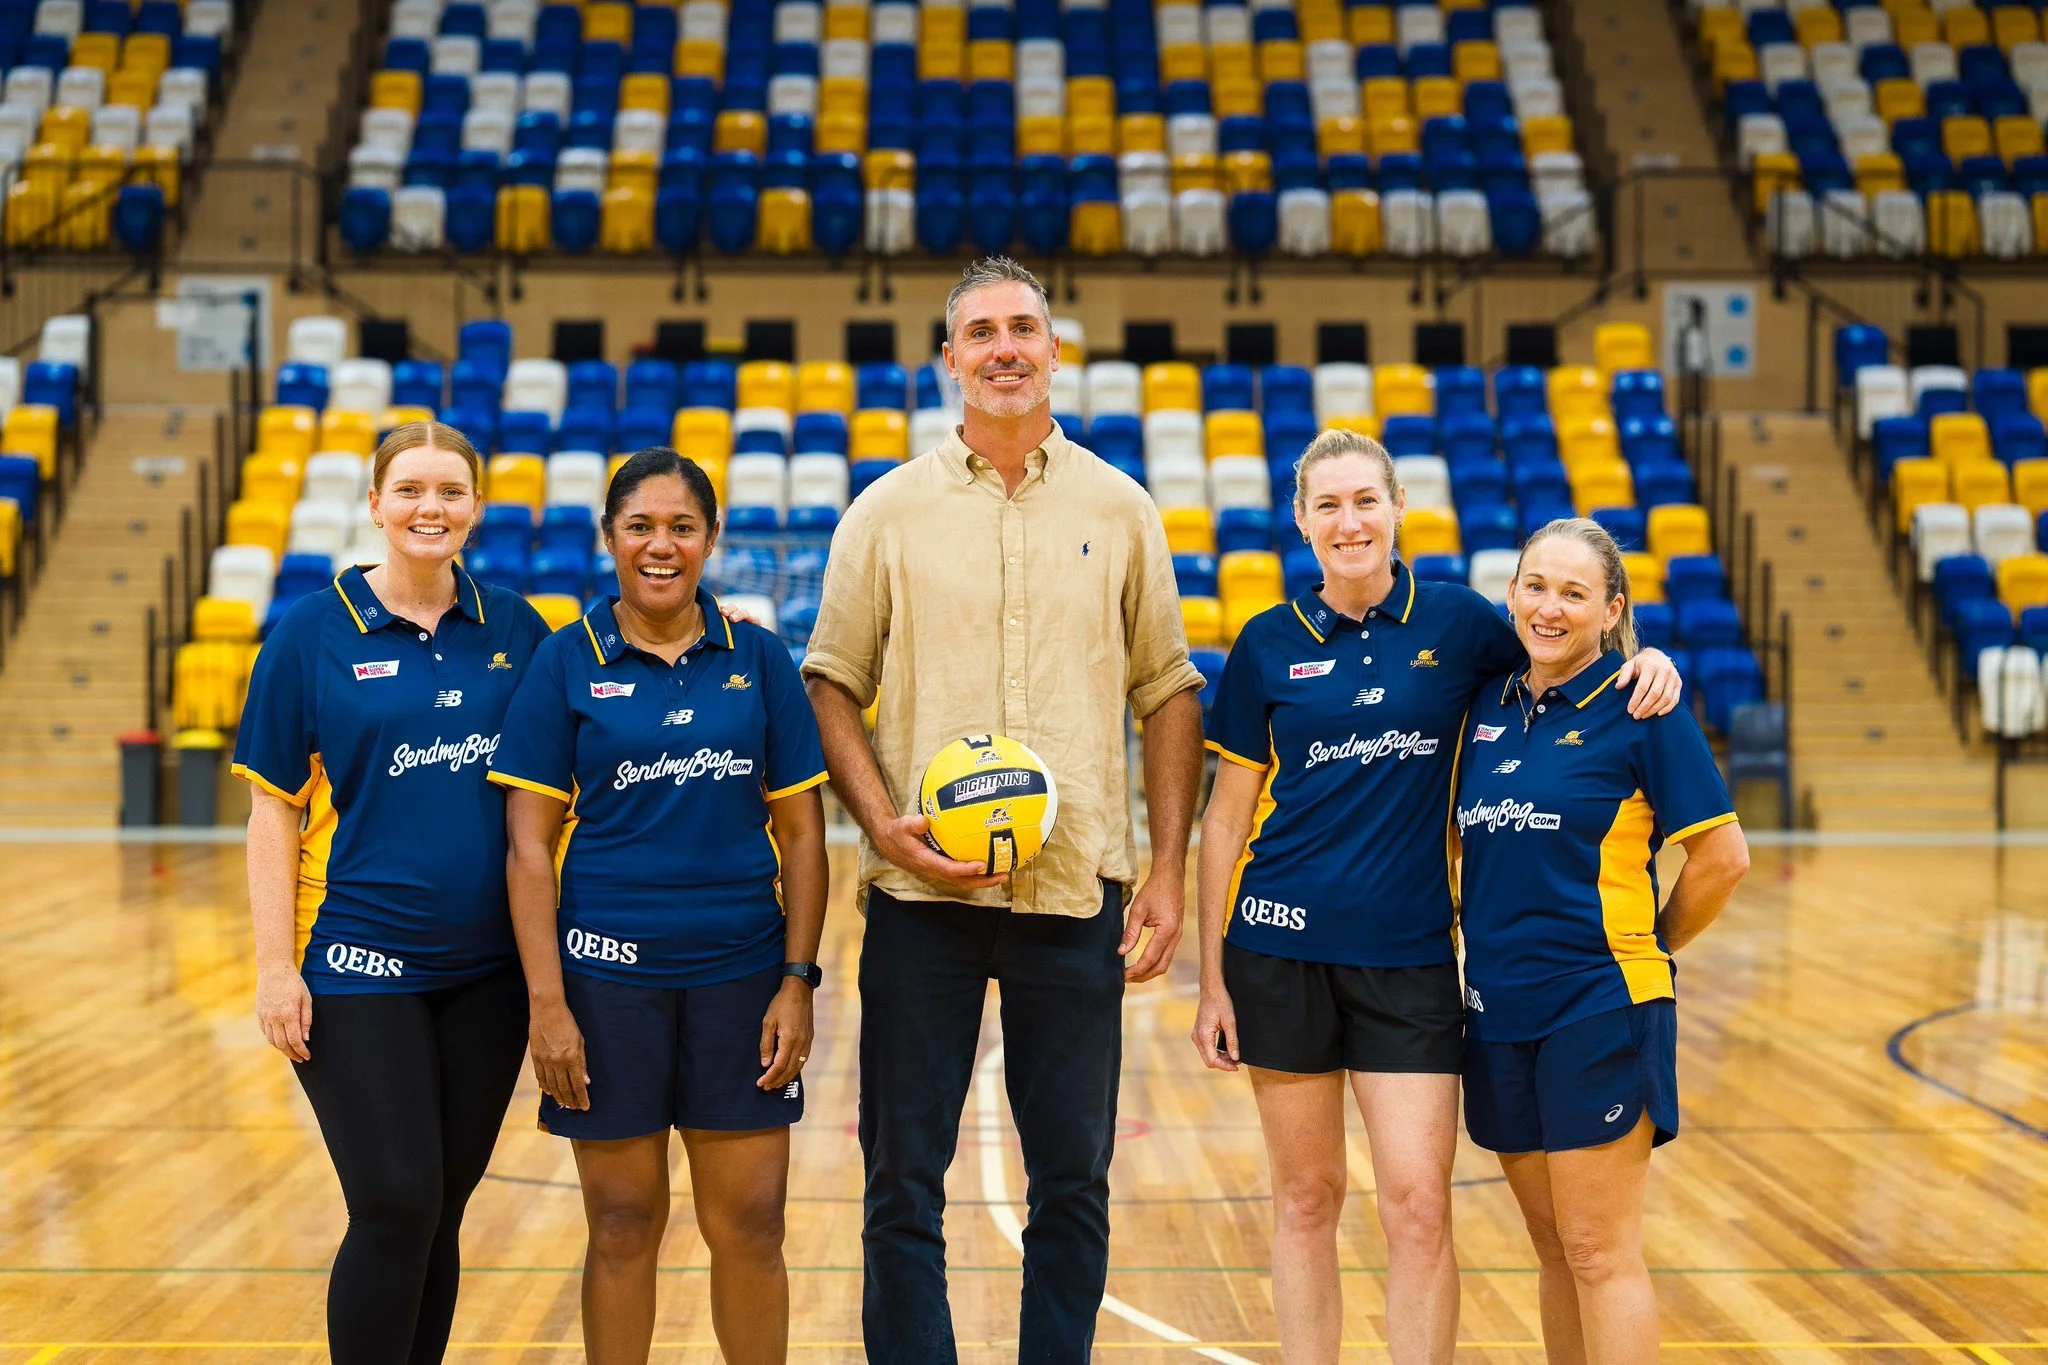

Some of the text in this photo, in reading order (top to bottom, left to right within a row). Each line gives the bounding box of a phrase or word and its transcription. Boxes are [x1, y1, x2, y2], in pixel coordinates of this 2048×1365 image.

[956, 772, 1030, 797] LIGHTNING
[985, 816, 1014, 825] LIGHTNING
[1241, 896, 1306, 931] QEBS
[326, 942, 404, 977] QEBS
[566, 928, 638, 965] QEBS
